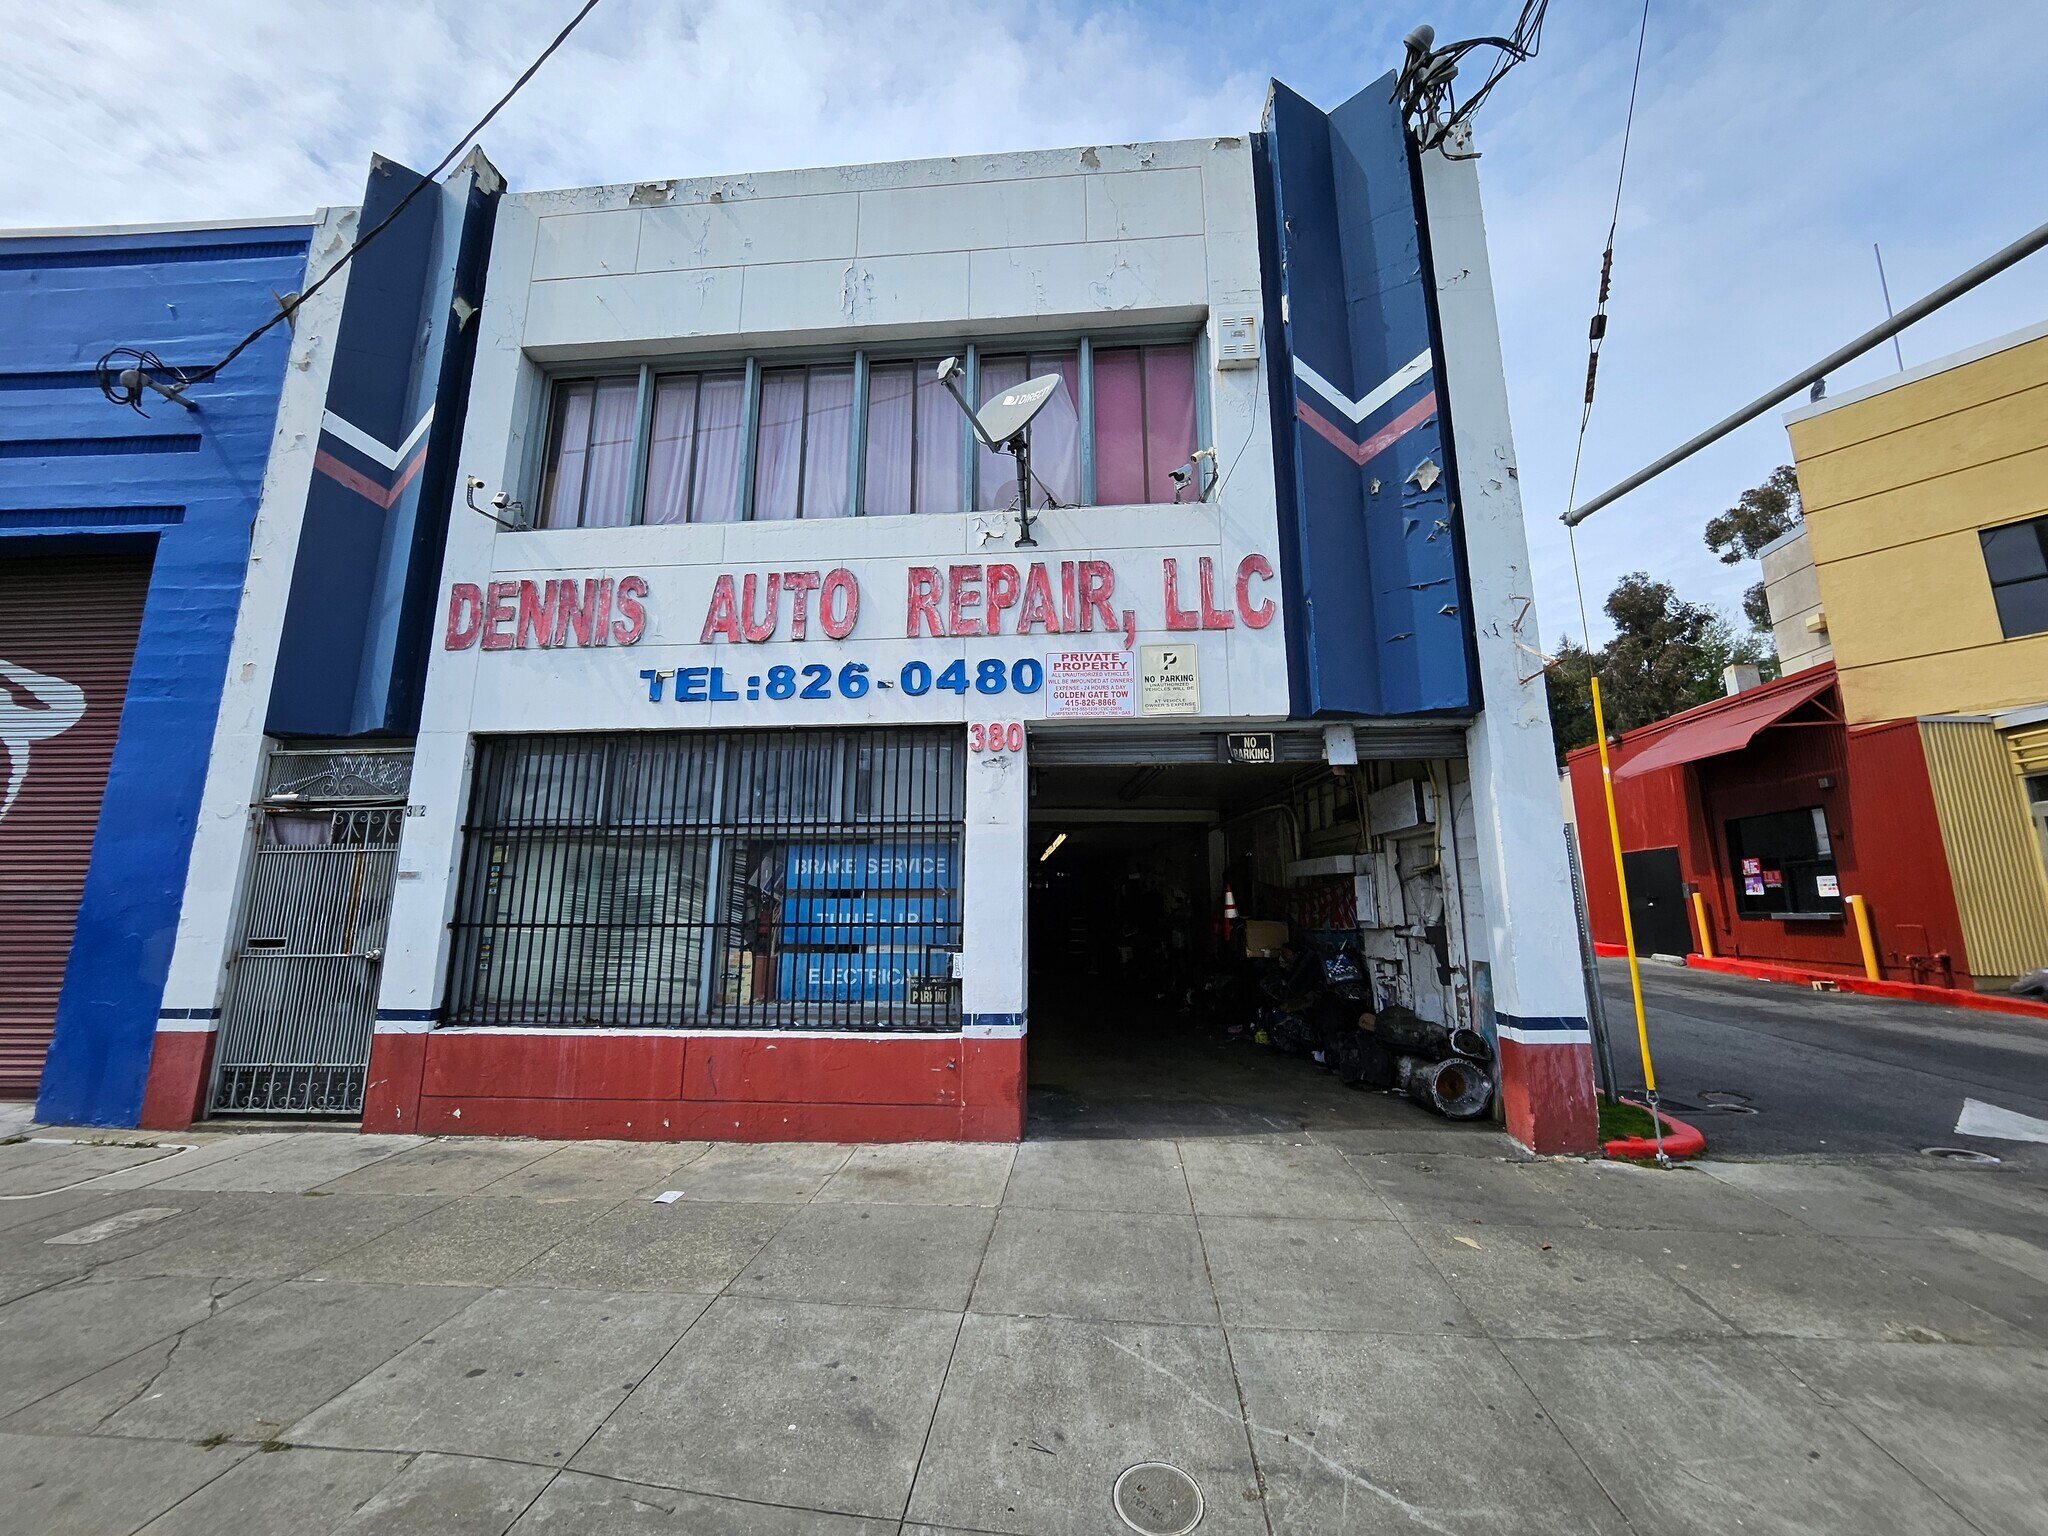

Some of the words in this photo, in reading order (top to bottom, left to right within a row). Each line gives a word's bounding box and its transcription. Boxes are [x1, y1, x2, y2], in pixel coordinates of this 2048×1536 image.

[444, 574, 648, 651] DENNIS
[700, 567, 859, 645] AUTO
[906, 558, 1136, 650] REPAIR,
[1163, 553, 1276, 632] LLC
[1061, 653, 1120, 661] PRIVATE
[1053, 662, 1128, 670] PROPERTY
[1144, 675, 1155, 683] NO
[1160, 674, 1194, 683] PARKING
[1053, 691, 1087, 699] GOLDEN
[1088, 691, 1110, 699] GATE
[1111, 690, 1129, 698] TOW
[1065, 699, 1117, 707] 415-826-8866
[969, 722, 1023, 752] 380
[1243, 736, 1257, 748] NO
[1233, 747, 1270, 760] PARKING
[795, 858, 857, 875] BRAKE
[867, 857, 946, 874] SERVICE
